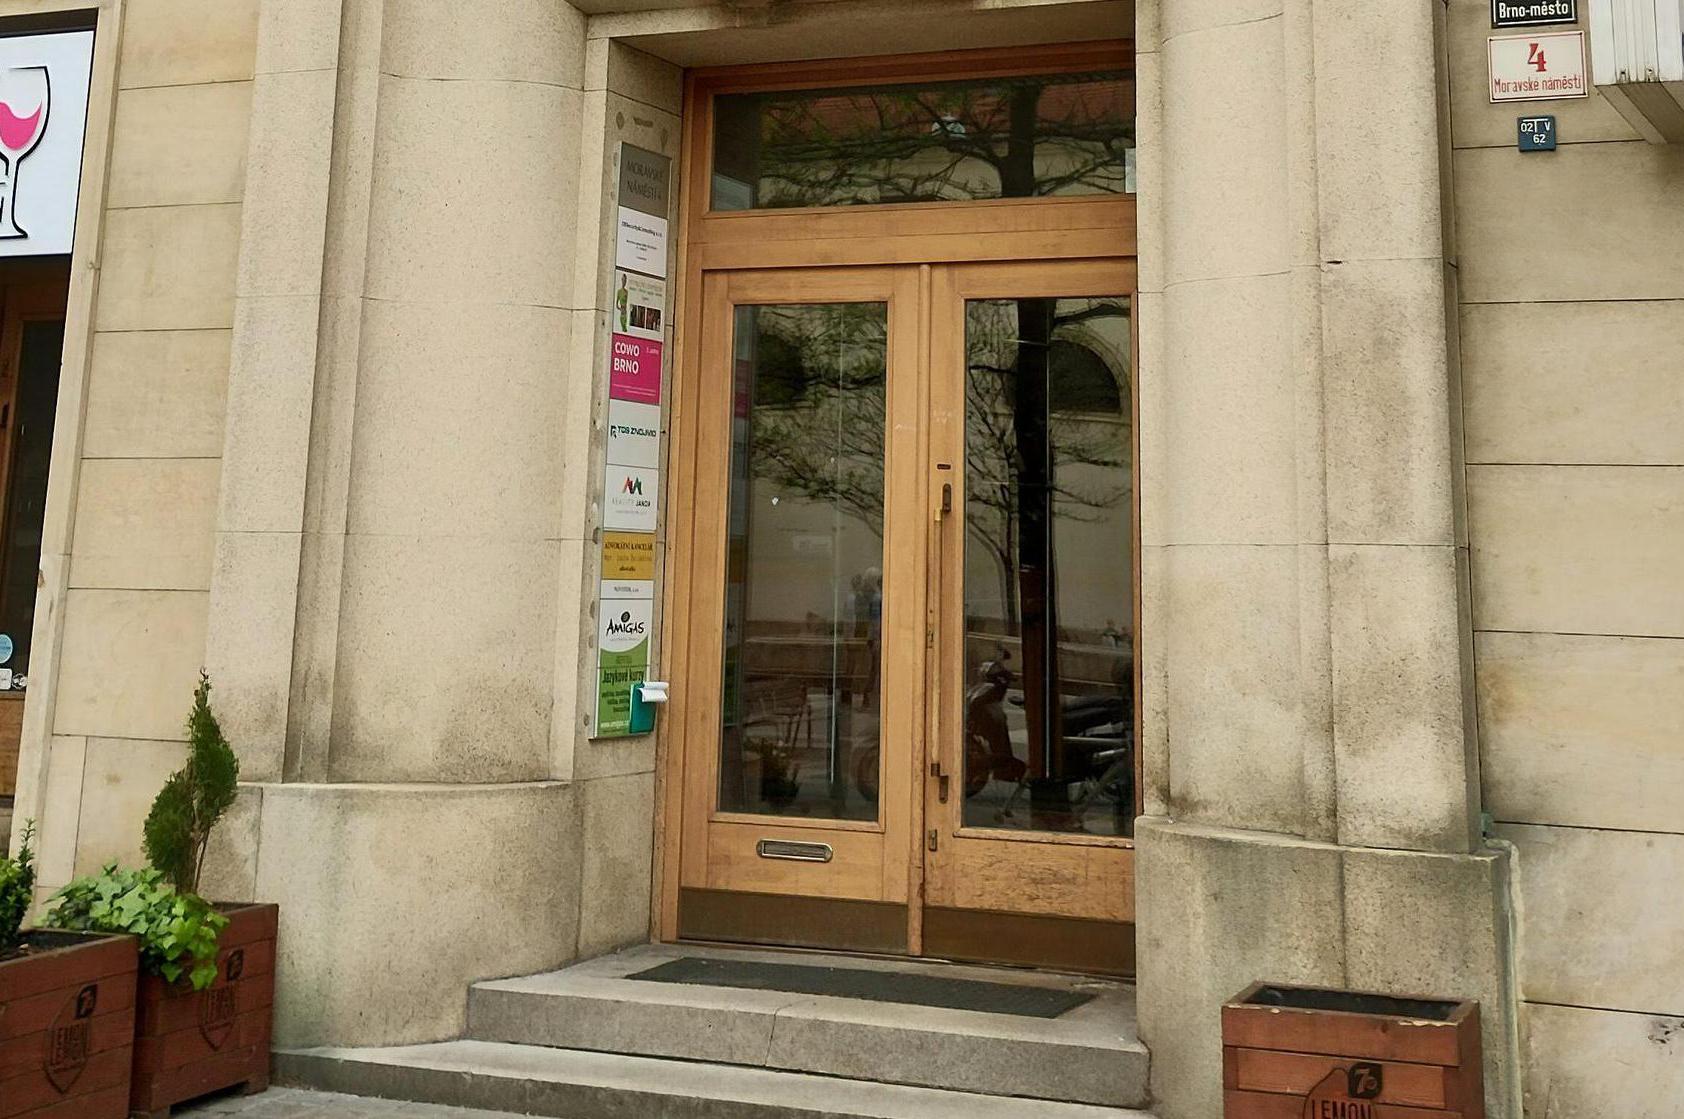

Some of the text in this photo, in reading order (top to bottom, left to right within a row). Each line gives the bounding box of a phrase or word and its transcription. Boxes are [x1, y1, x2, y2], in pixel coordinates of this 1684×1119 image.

[1499, 0, 1569, 18] Brno-město
[1527, 43, 1547, 72] 4
[1533, 134, 1546, 144] 62
[614, 342, 640, 357] COWO
[613, 357, 639, 375] BRNO
[606, 618, 645, 636] AMIGAS
[1312, 1100, 1371, 1119] LEMON
